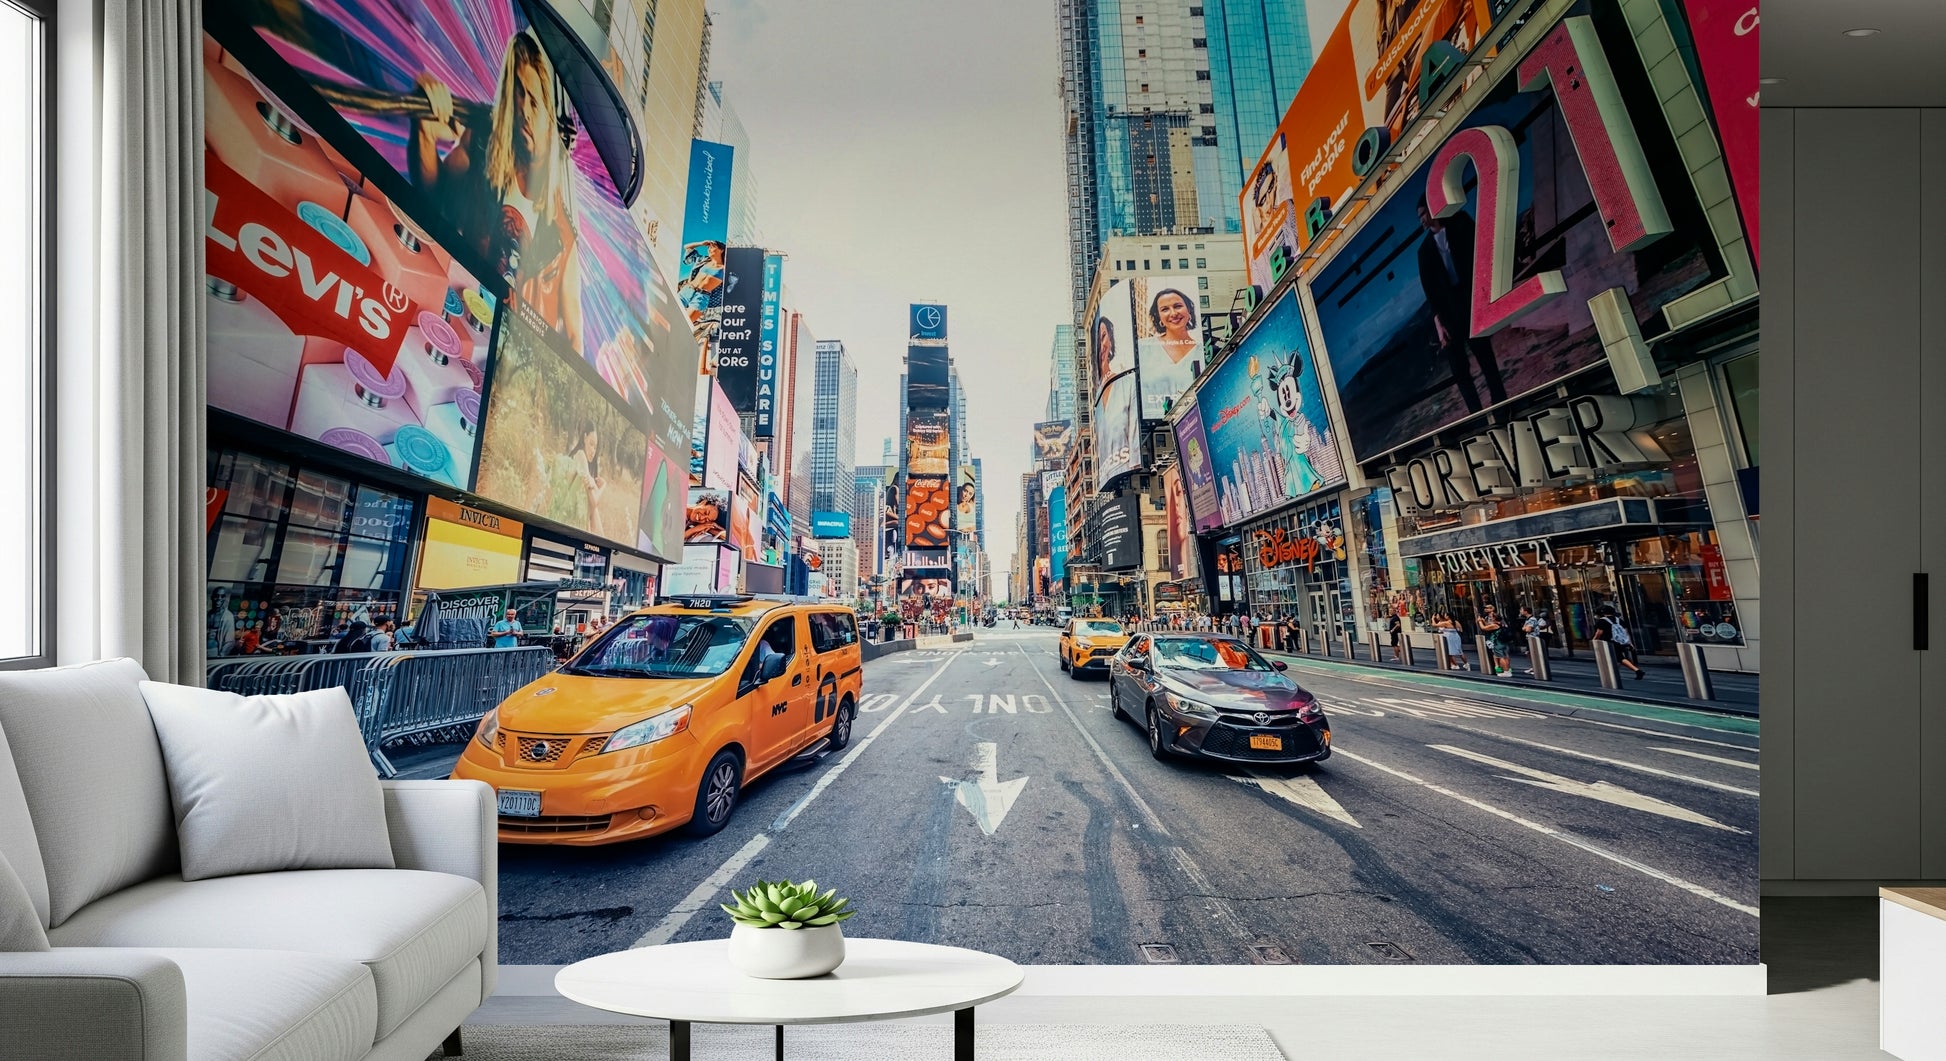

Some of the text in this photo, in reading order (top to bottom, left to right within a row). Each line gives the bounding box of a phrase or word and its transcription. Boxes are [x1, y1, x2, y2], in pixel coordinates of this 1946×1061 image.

[1300, 109, 1350, 187] Find your
[1308, 138, 1346, 198] people
[1426, 16, 1660, 338] 21
[520, 310, 545, 337] MARQUIS
[758, 263, 777, 426] TIMES SQUARE
[1385, 395, 1630, 514] FOREVER
[459, 508, 500, 530] INVICTA
[584, 543, 600, 552] SEPHORA
[1436, 538, 1556, 574] FOREVER 21
[440, 596, 500, 610] DISCOVER
[772, 701, 788, 718] NYC
[910, 693, 1054, 715] ONLY
